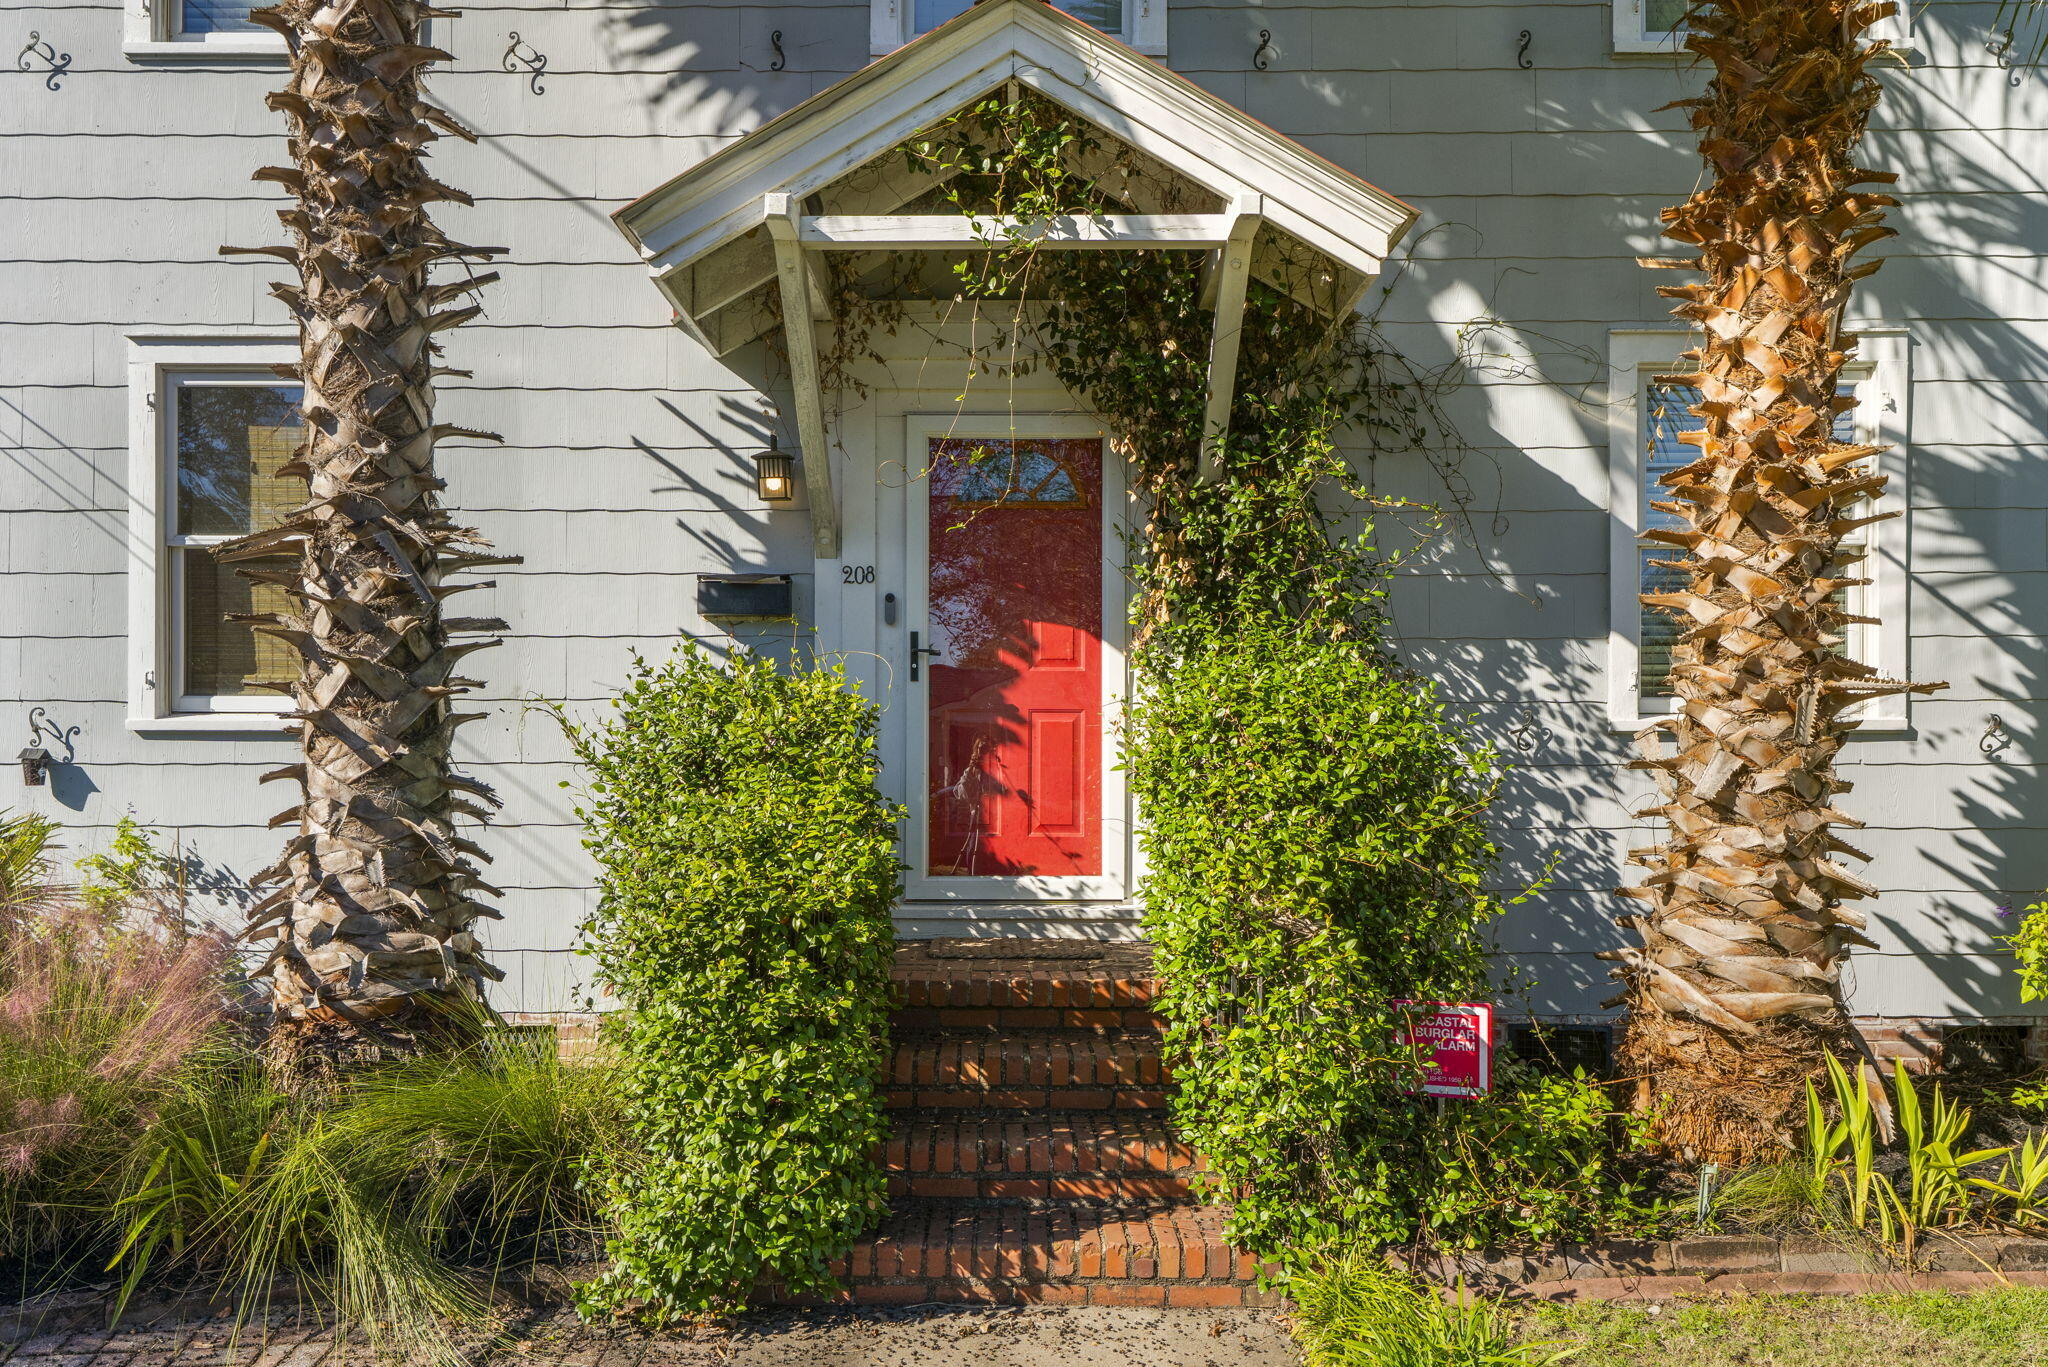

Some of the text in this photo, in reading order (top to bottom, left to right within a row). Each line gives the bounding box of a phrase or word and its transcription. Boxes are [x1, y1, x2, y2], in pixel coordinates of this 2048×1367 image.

[842, 565, 875, 585] 208
[1415, 1027, 1475, 1040] BURGLAR
[1433, 1039, 1475, 1052] ALARM
